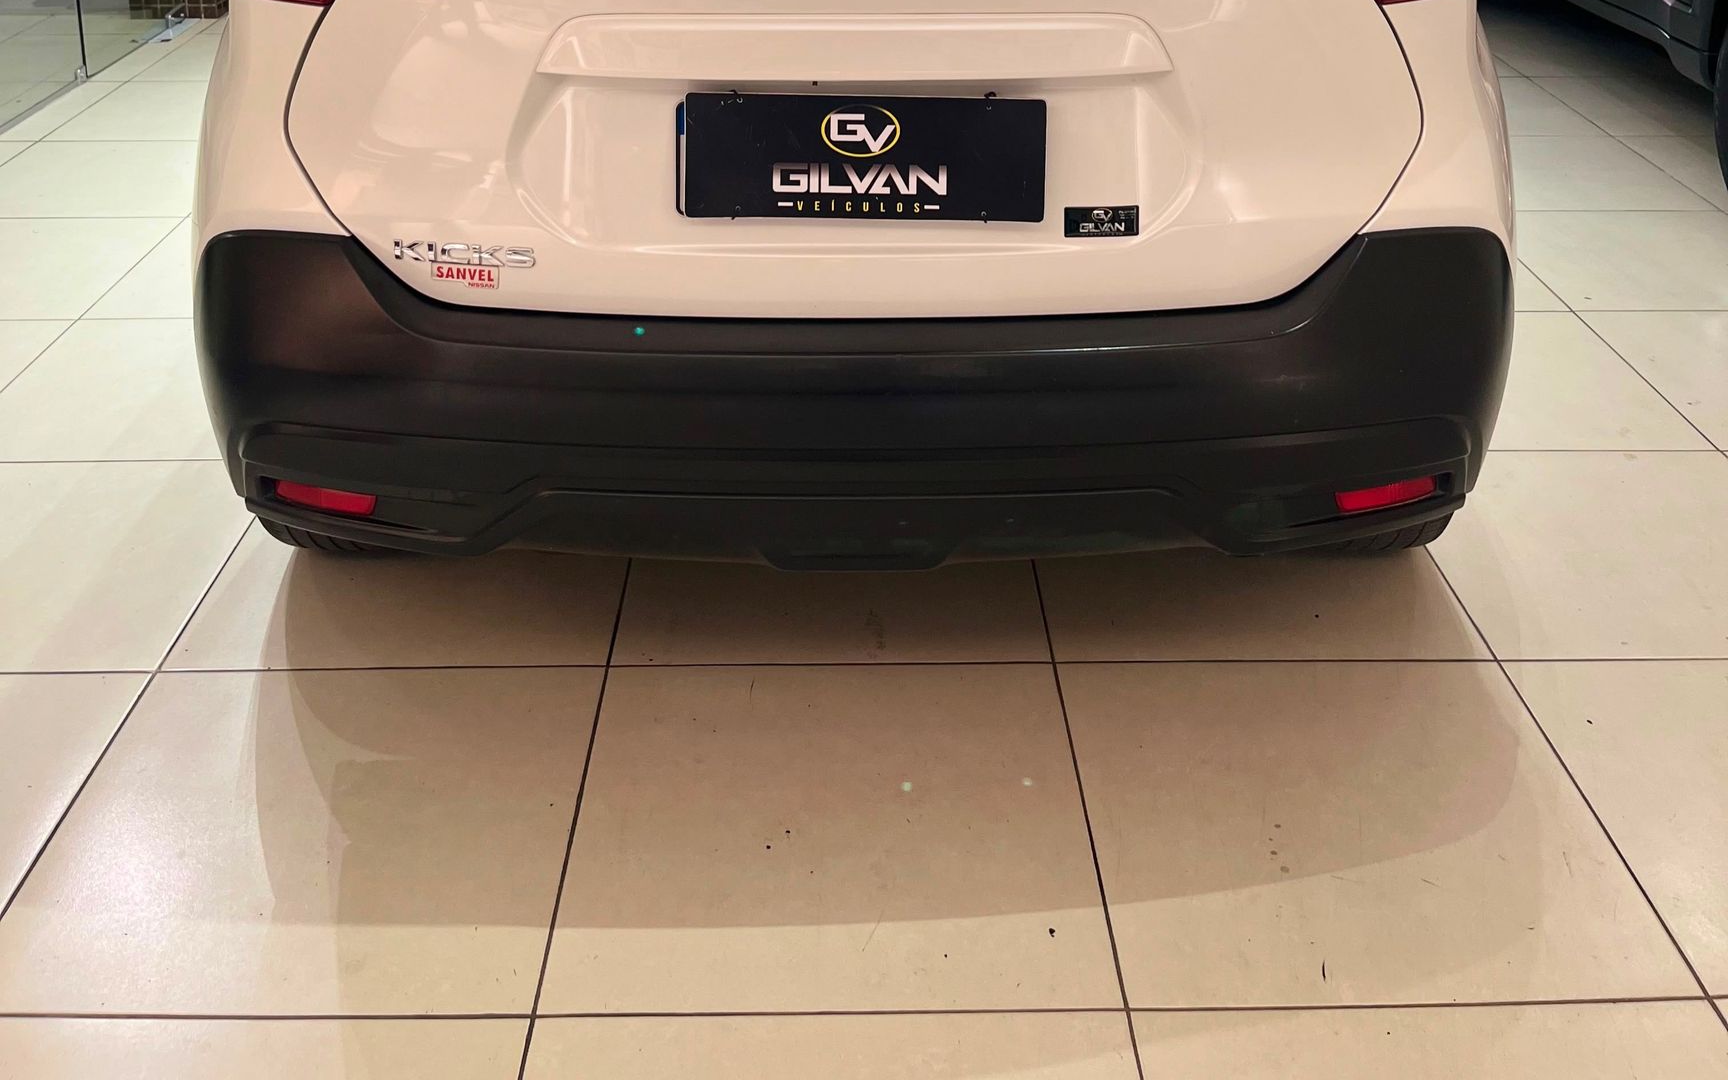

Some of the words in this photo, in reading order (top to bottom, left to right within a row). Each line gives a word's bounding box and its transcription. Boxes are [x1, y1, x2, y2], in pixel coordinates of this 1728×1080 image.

[830, 113, 896, 153] GV
[772, 162, 948, 196] GILVAN
[797, 199, 920, 213] VEÍCULOS
[1079, 222, 1125, 233] GILVAN
[393, 238, 537, 268] KICKS
[436, 265, 495, 282] SANVEL
